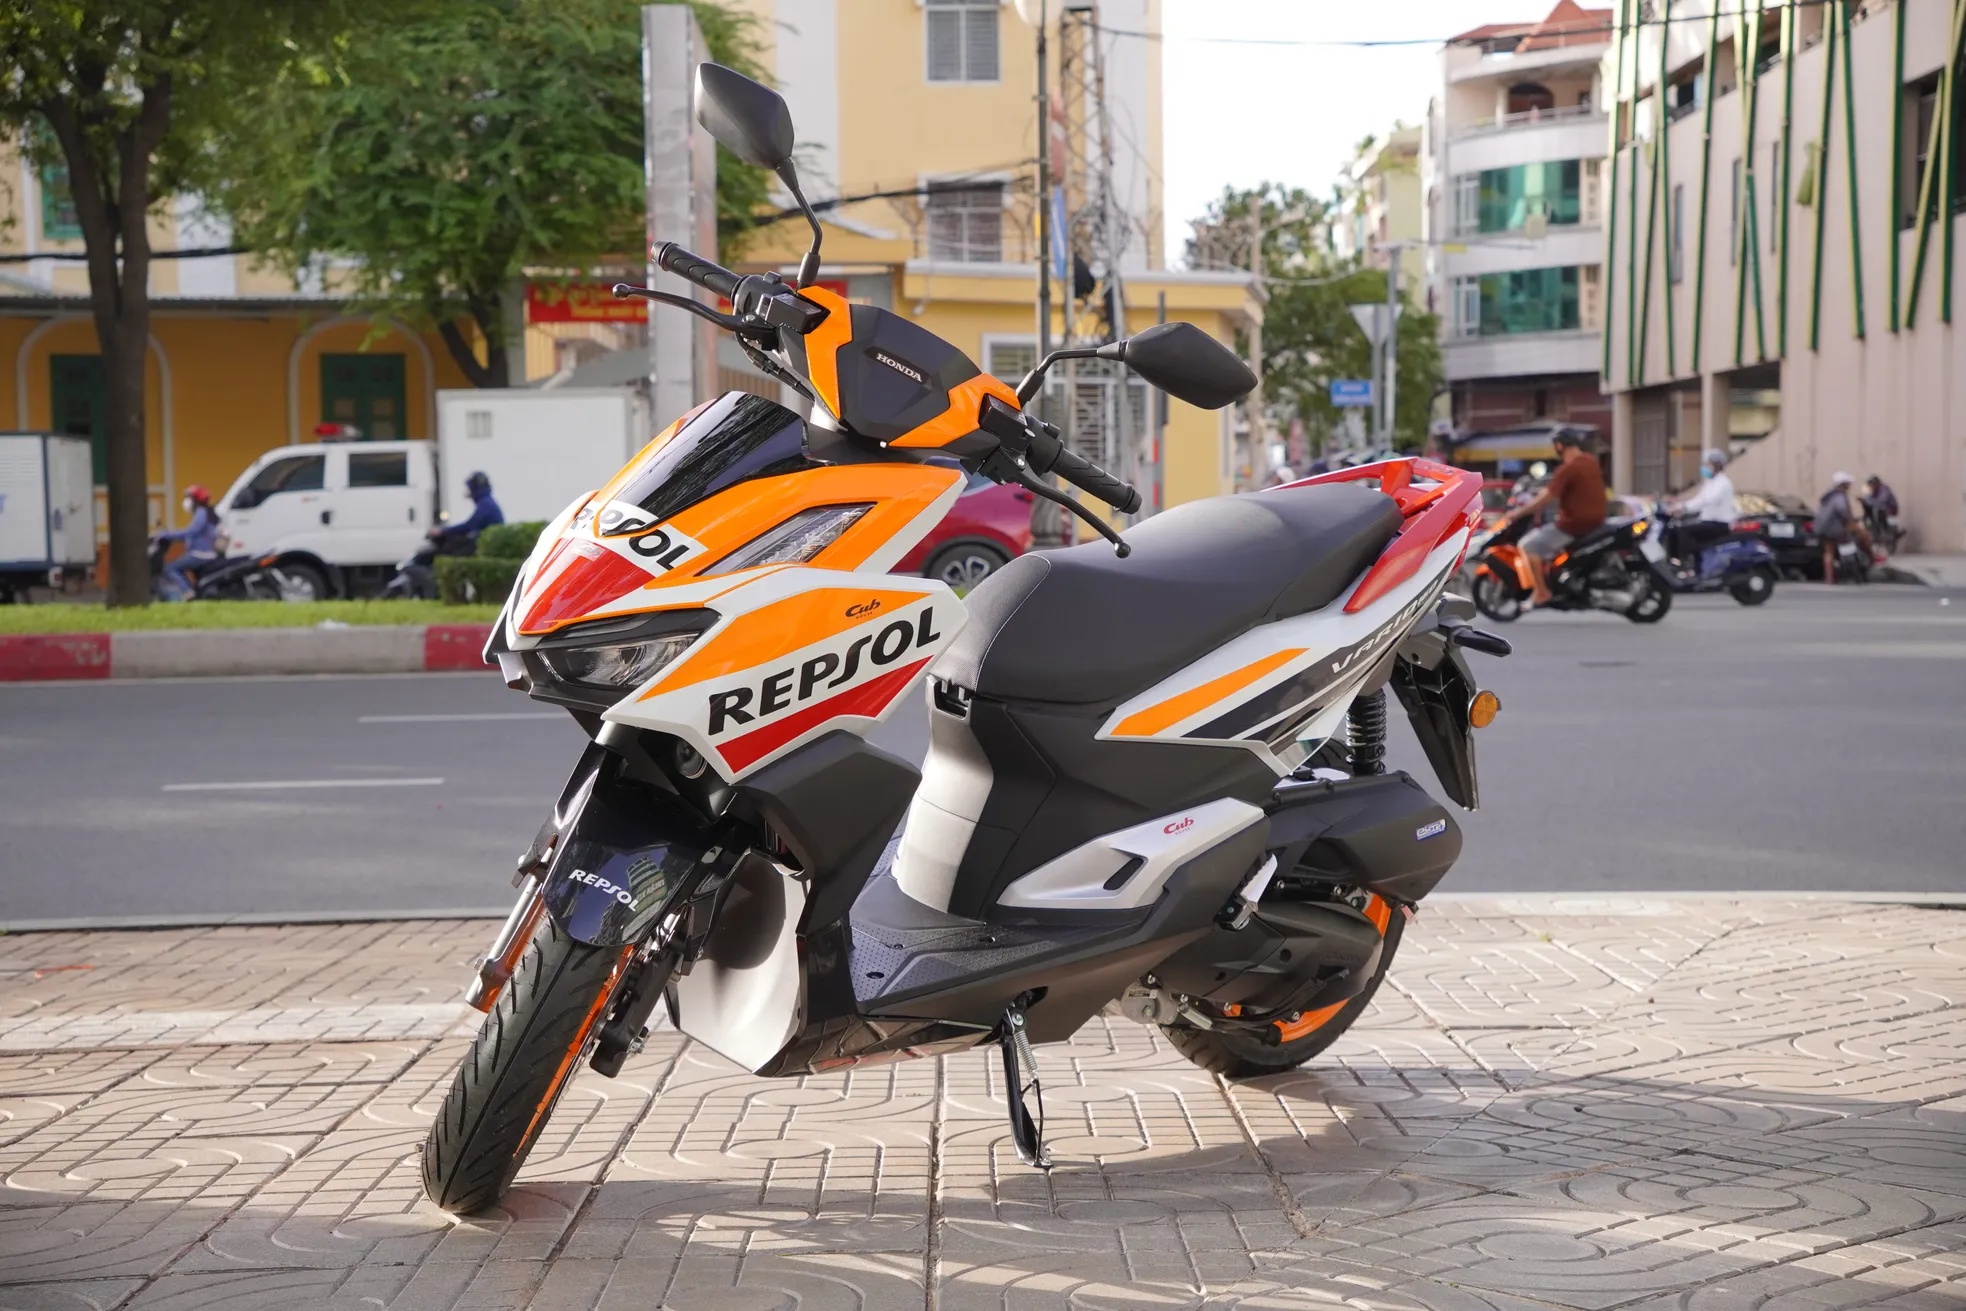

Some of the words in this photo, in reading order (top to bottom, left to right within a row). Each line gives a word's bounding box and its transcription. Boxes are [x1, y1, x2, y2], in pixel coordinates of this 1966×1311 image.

[876, 353, 922, 382] HONDA
[845, 599, 880, 617] Cub
[1332, 600, 1418, 673] VARIO
[708, 606, 941, 736] REPSOL
[1163, 817, 1194, 834] Cub
[568, 869, 639, 912] REPSOL
